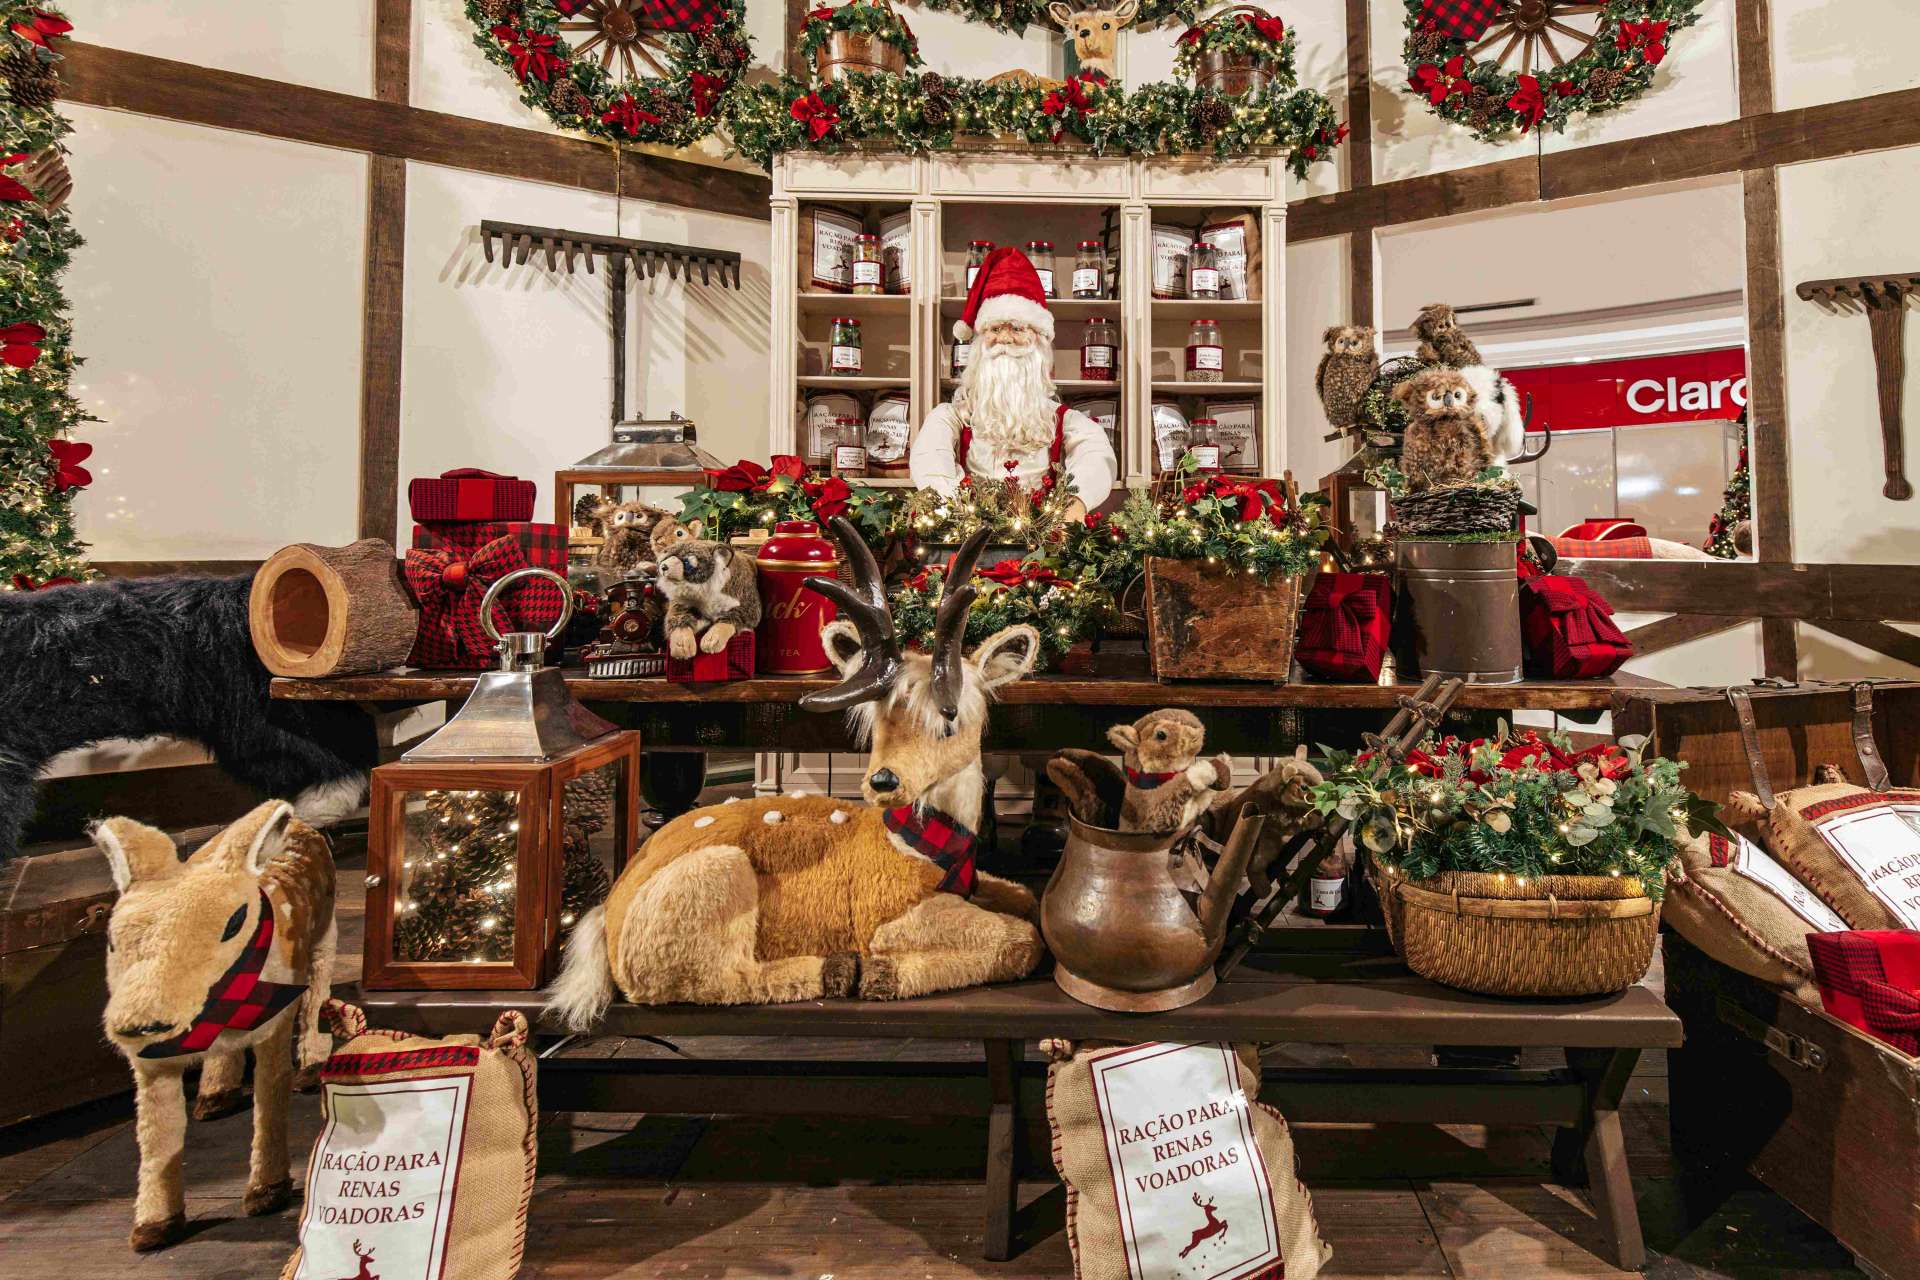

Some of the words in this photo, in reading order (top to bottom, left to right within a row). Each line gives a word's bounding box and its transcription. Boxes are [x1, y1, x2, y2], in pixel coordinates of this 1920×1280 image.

[1233, 422, 1251, 430] PARA
[779, 649, 801, 657] TEA
[1119, 1112, 1184, 1146] RAÇÃO
[1187, 1100, 1234, 1125] PARA
[1153, 1130, 1213, 1162] RENAS
[322, 1151, 380, 1175] RAÇÃO
[383, 1151, 441, 1172] PARA
[1136, 1147, 1239, 1193] VOADORAS
[338, 1180, 401, 1198] RENAS
[319, 1201, 425, 1225] VOADORAS
